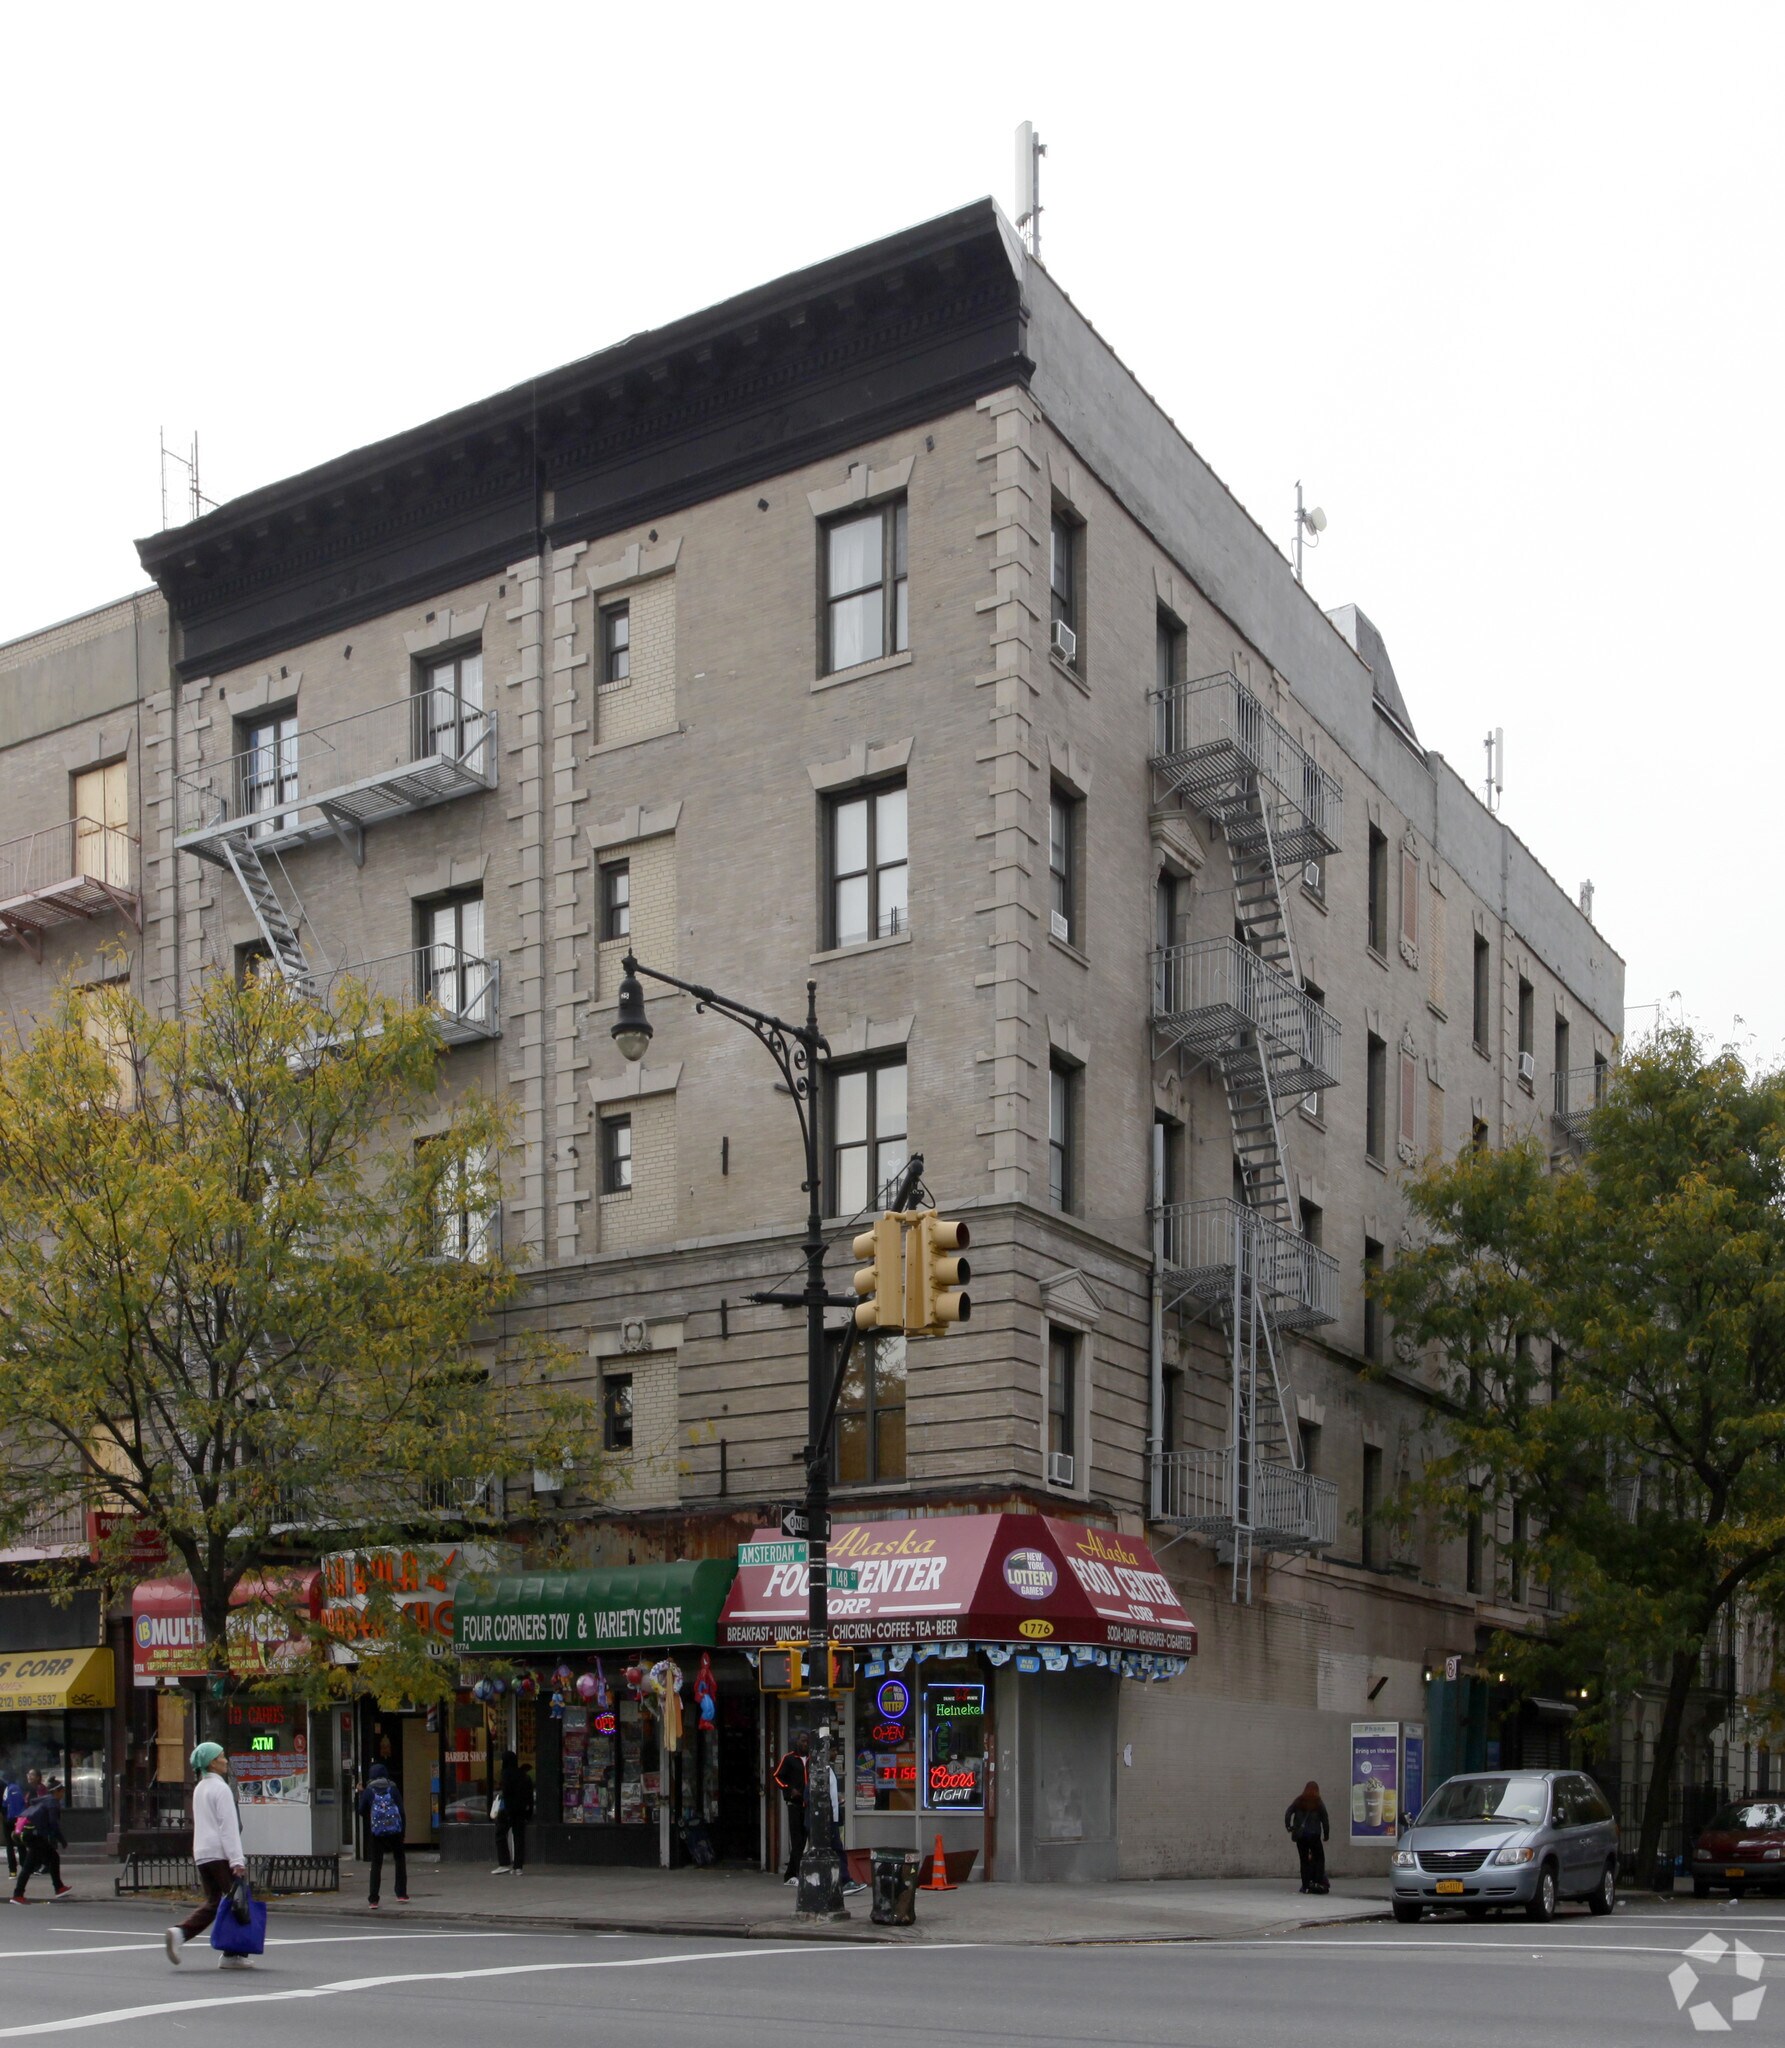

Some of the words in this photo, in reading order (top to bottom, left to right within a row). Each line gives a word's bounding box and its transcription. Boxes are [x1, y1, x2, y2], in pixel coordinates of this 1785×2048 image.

[789, 1516, 806, 1530] ONE
[826, 1526, 936, 1557] Alaska
[1076, 1528, 1139, 1566] Alaska
[741, 1545, 795, 1564] AMSTERDAM
[798, 1544, 806, 1553] AV
[1027, 1551, 1042, 1562] NEW
[1027, 1561, 1045, 1571] YORK
[835, 1570, 848, 1588] 148
[851, 1571, 857, 1581] ST
[1007, 1569, 1053, 1586] LOTTERY
[1066, 1555, 1120, 1597] FOOD
[1113, 1566, 1181, 1607] CENTER
[1021, 1586, 1044, 1596] GAMES
[826, 1598, 871, 1615] ORP.
[1127, 1604, 1160, 1623] CORP.
[462, 1615, 492, 1642] FOUR
[494, 1614, 547, 1641] CORNERS
[549, 1613, 570, 1640] TOY
[577, 1612, 587, 1639] &
[594, 1608, 641, 1639] VARIETY
[643, 1606, 682, 1635] STORE
[727, 1625, 770, 1642] BREAKFAST
[774, 1625, 802, 1641] LUNCH
[832, 1623, 872, 1640] CHICKEN
[876, 1621, 914, 1638] COFFEE
[916, 1620, 932, 1636] TEA
[936, 1620, 958, 1636] BEER
[1024, 1623, 1050, 1635] 1776
[1107, 1624, 1121, 1641] SODA
[1123, 1627, 1138, 1644] DAIRY
[1138, 1630, 1165, 1648] NEWSPAPER
[1166, 1633, 1192, 1652] CIGARETTES
[455, 1643, 470, 1651] 1774
[936, 1703, 981, 1716] Heineke
[595, 1716, 615, 1731] OPE
[872, 1725, 905, 1740] OPEN
[251, 1736, 273, 1751] ATM
[444, 1751, 469, 1763] BARBER
[470, 1751, 487, 1762] SHOP
[883, 1767, 897, 1780] 37
[930, 1765, 976, 1789] Coors
[932, 1788, 972, 1802] LIGHT
